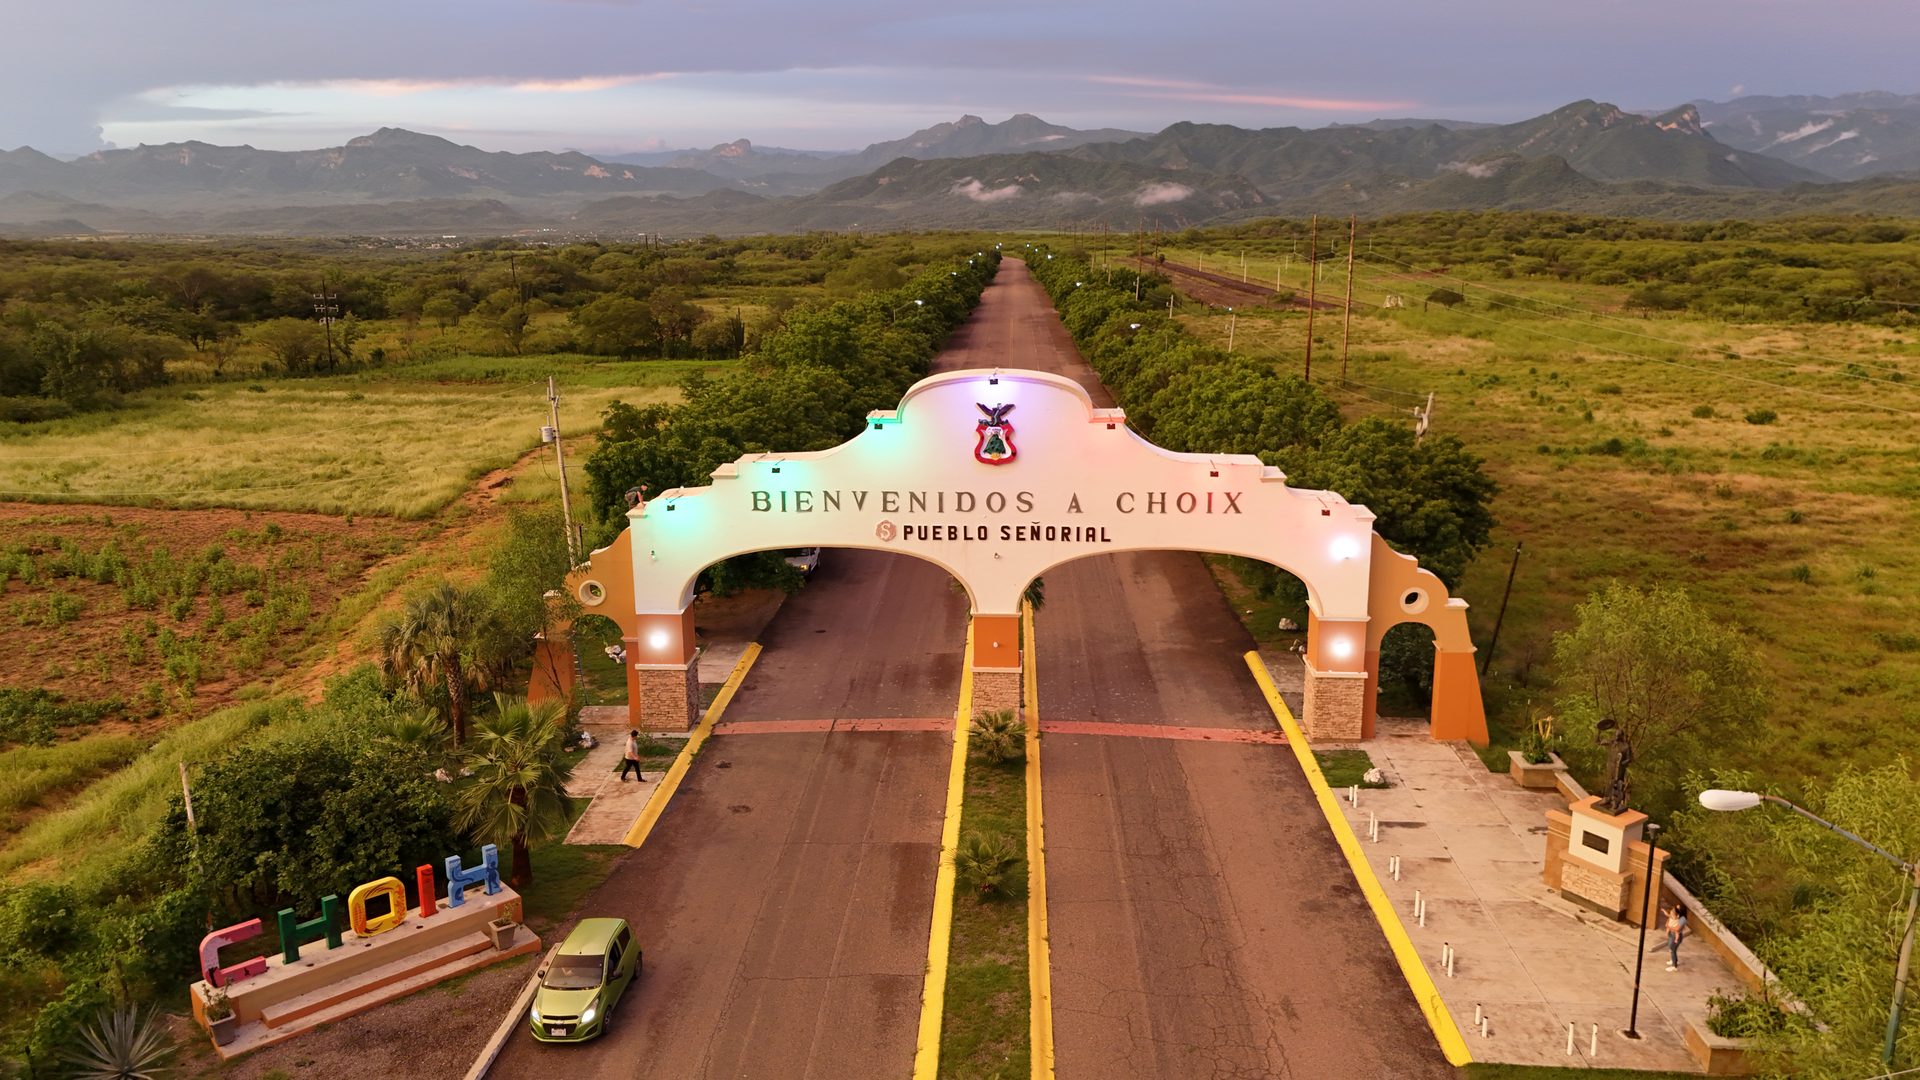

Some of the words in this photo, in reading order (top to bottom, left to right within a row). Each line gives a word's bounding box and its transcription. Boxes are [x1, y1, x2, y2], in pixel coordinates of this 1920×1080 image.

[751, 490, 1034, 514] BIENVENIDOS
[1067, 491, 1084, 514] A
[1116, 491, 1243, 515] CHOIX
[903, 524, 989, 542] PUEBLO
[1000, 520, 1112, 543] SEÑORIAL
